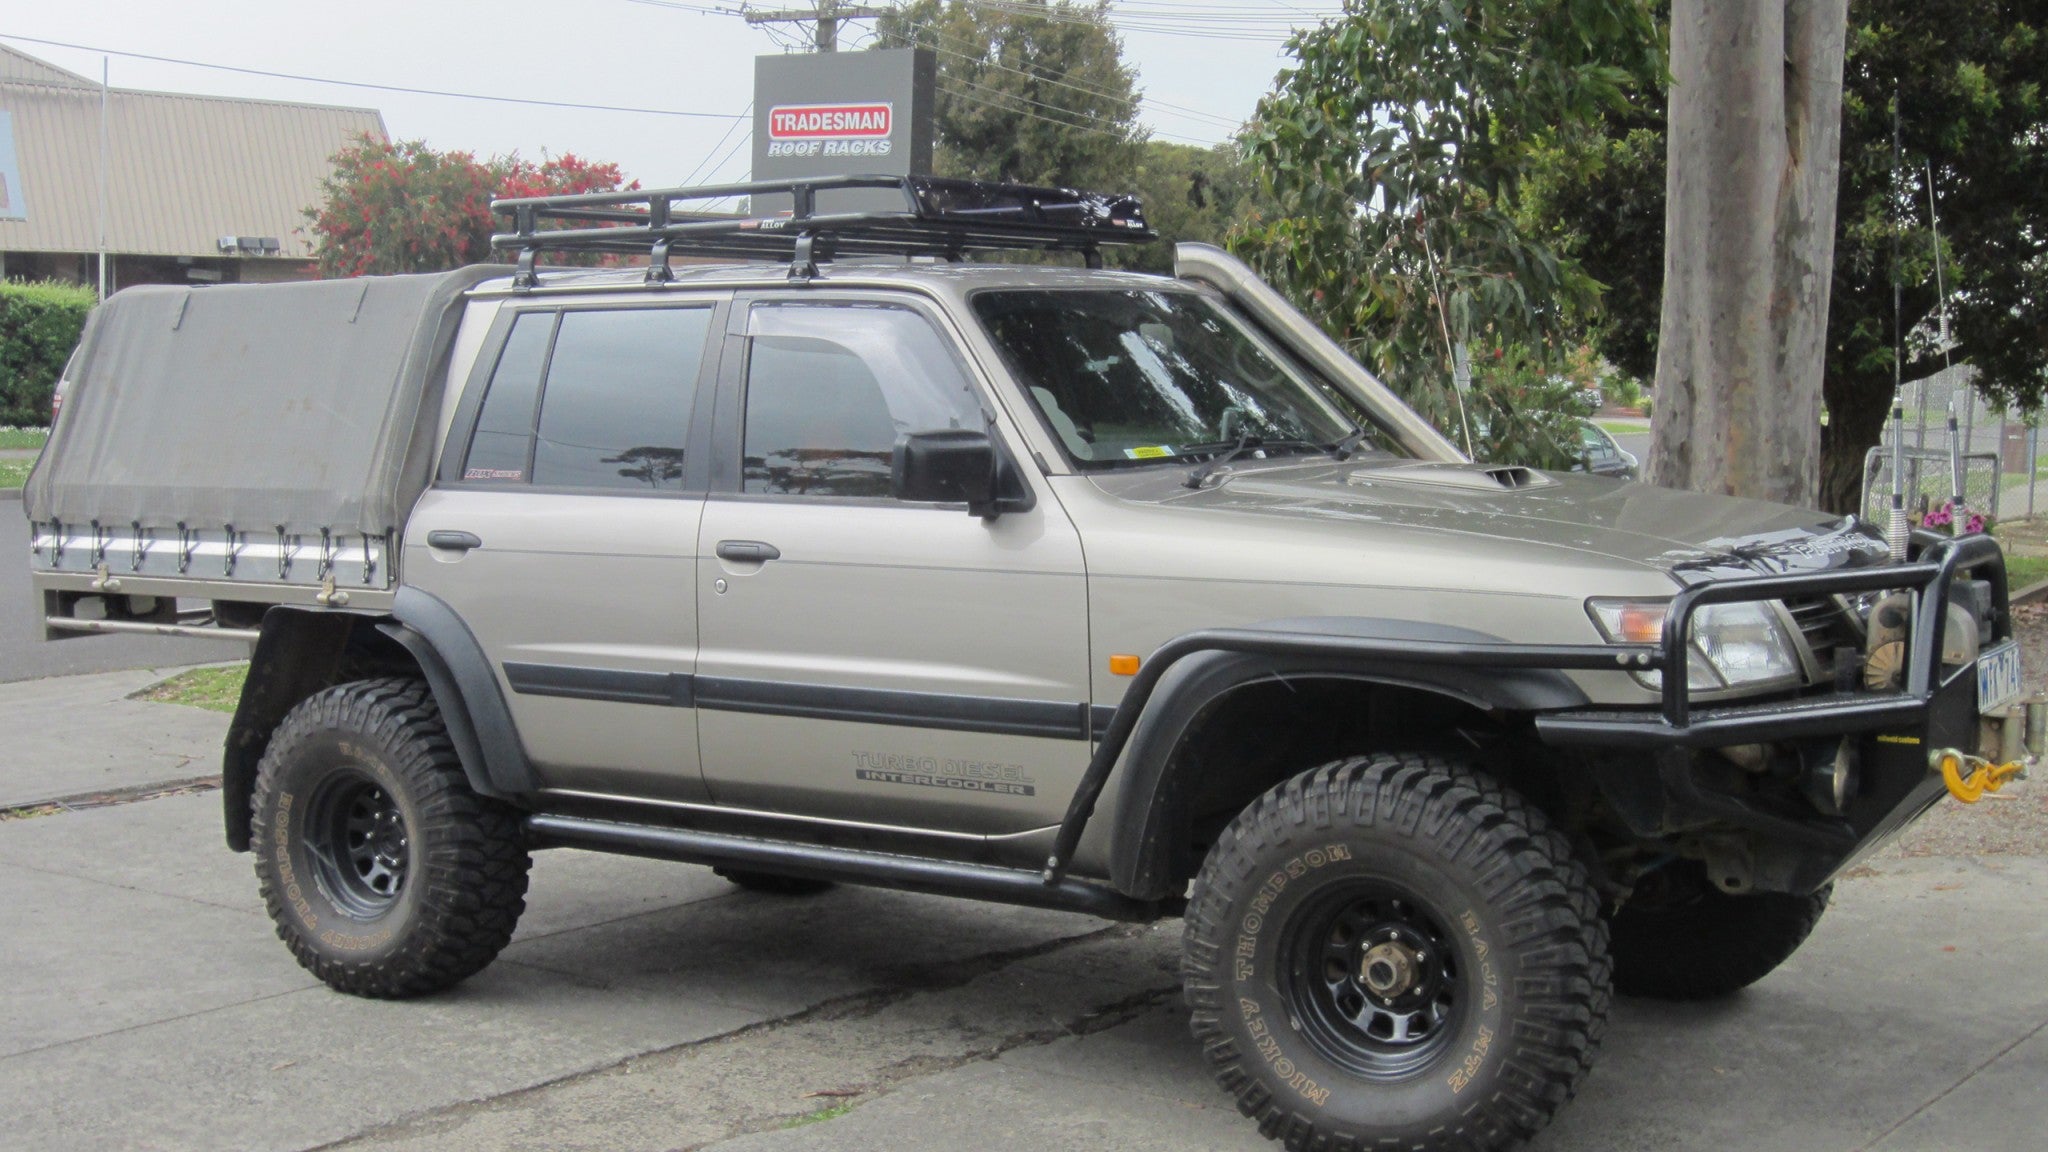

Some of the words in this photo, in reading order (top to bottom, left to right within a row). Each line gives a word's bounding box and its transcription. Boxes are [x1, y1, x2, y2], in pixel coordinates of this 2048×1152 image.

[774, 111, 886, 131] TRADESMAN
[767, 141, 822, 157] ROOF
[823, 140, 892, 156] RACKS
[852, 750, 937, 775] TURBO
[942, 758, 1035, 783] DIESEL
[865, 770, 1026, 796] INTERCOOLER
[1236, 843, 1351, 981] THOMPSON
[1460, 909, 1498, 1011] BAJA
[1240, 997, 1330, 1106] MICKEY
[1448, 1024, 1494, 1094] MTZ
